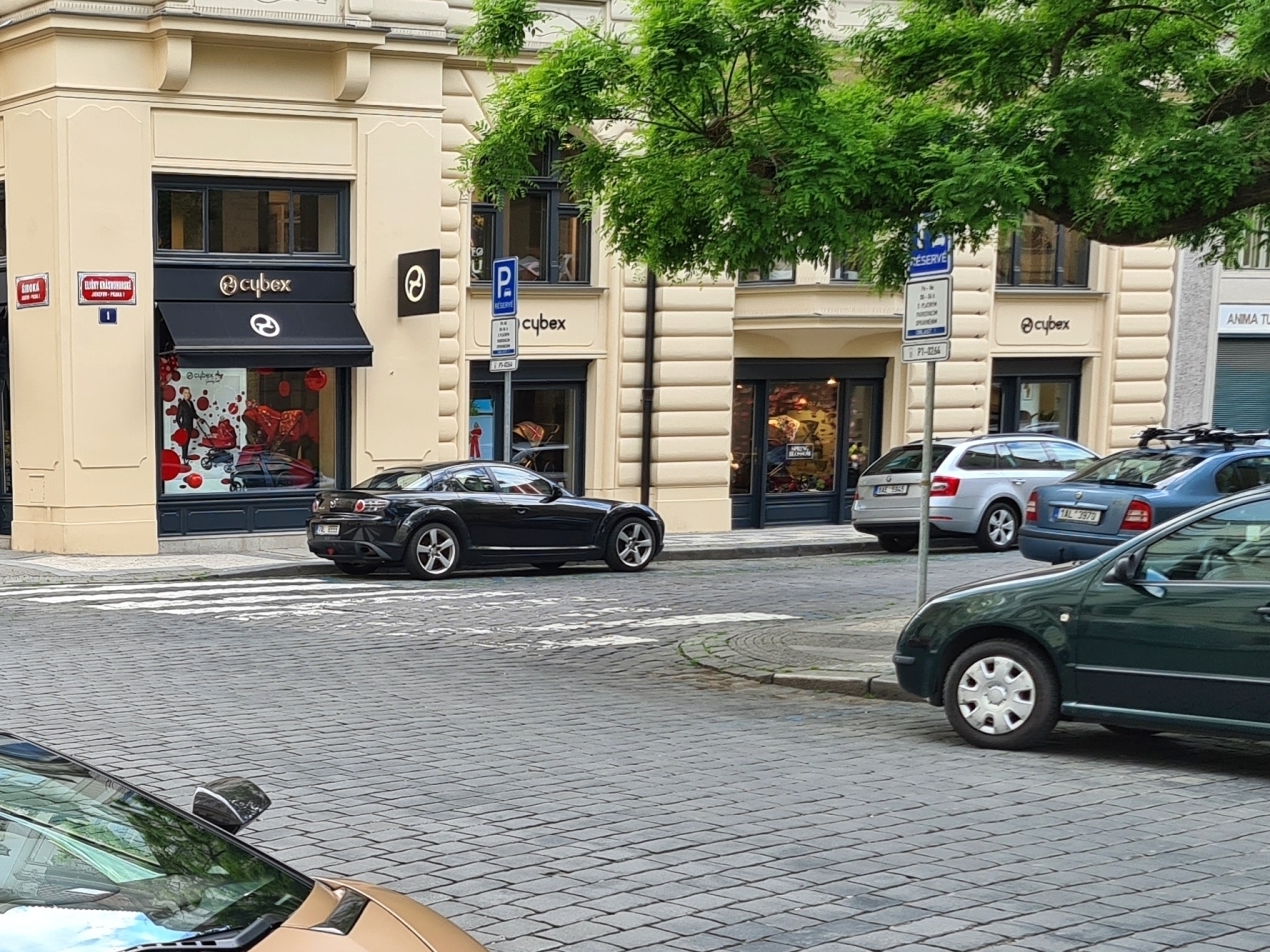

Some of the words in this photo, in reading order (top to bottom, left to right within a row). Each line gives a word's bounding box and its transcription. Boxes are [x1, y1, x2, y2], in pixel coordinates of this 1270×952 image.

[239, 272, 292, 299] cybex
[498, 266, 511, 299] P
[522, 313, 566, 337] cybex
[1034, 315, 1070, 336] cybex
[1227, 313, 1258, 325] ANIMA
